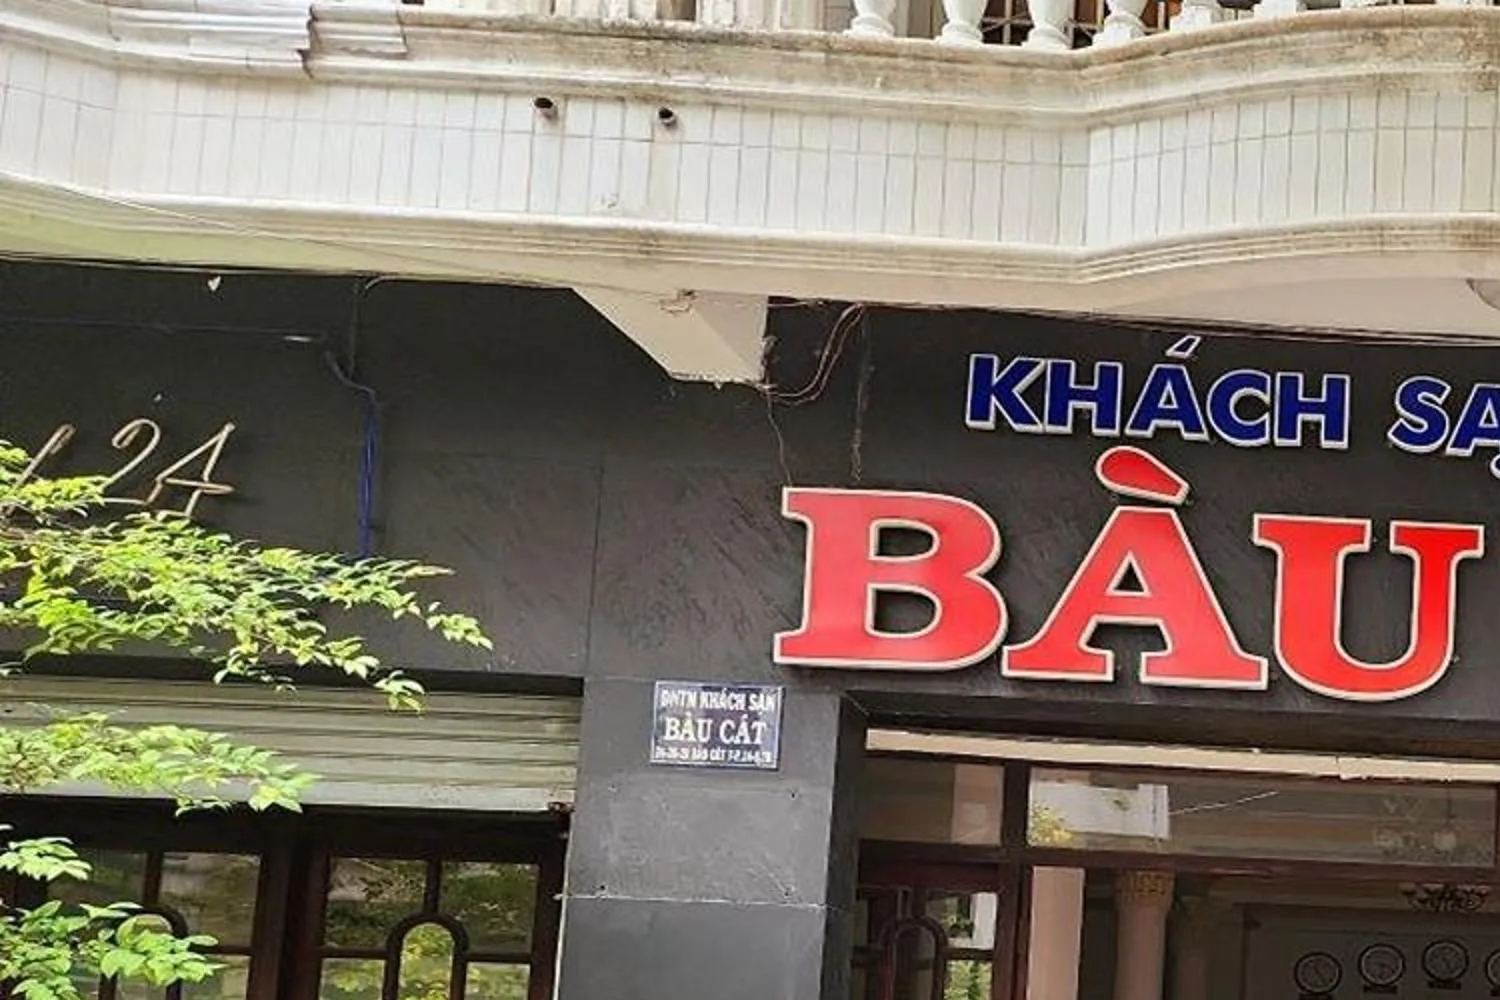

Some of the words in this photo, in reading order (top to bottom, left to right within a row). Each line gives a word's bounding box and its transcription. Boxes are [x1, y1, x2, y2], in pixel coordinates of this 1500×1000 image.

[966, 335, 1350, 449] KHÁCH
[773, 445, 1485, 702] BÀU
[663, 711, 713, 744] BÀU
[719, 714, 767, 745] CÁT
[699, 687, 747, 711] KHÁCH
